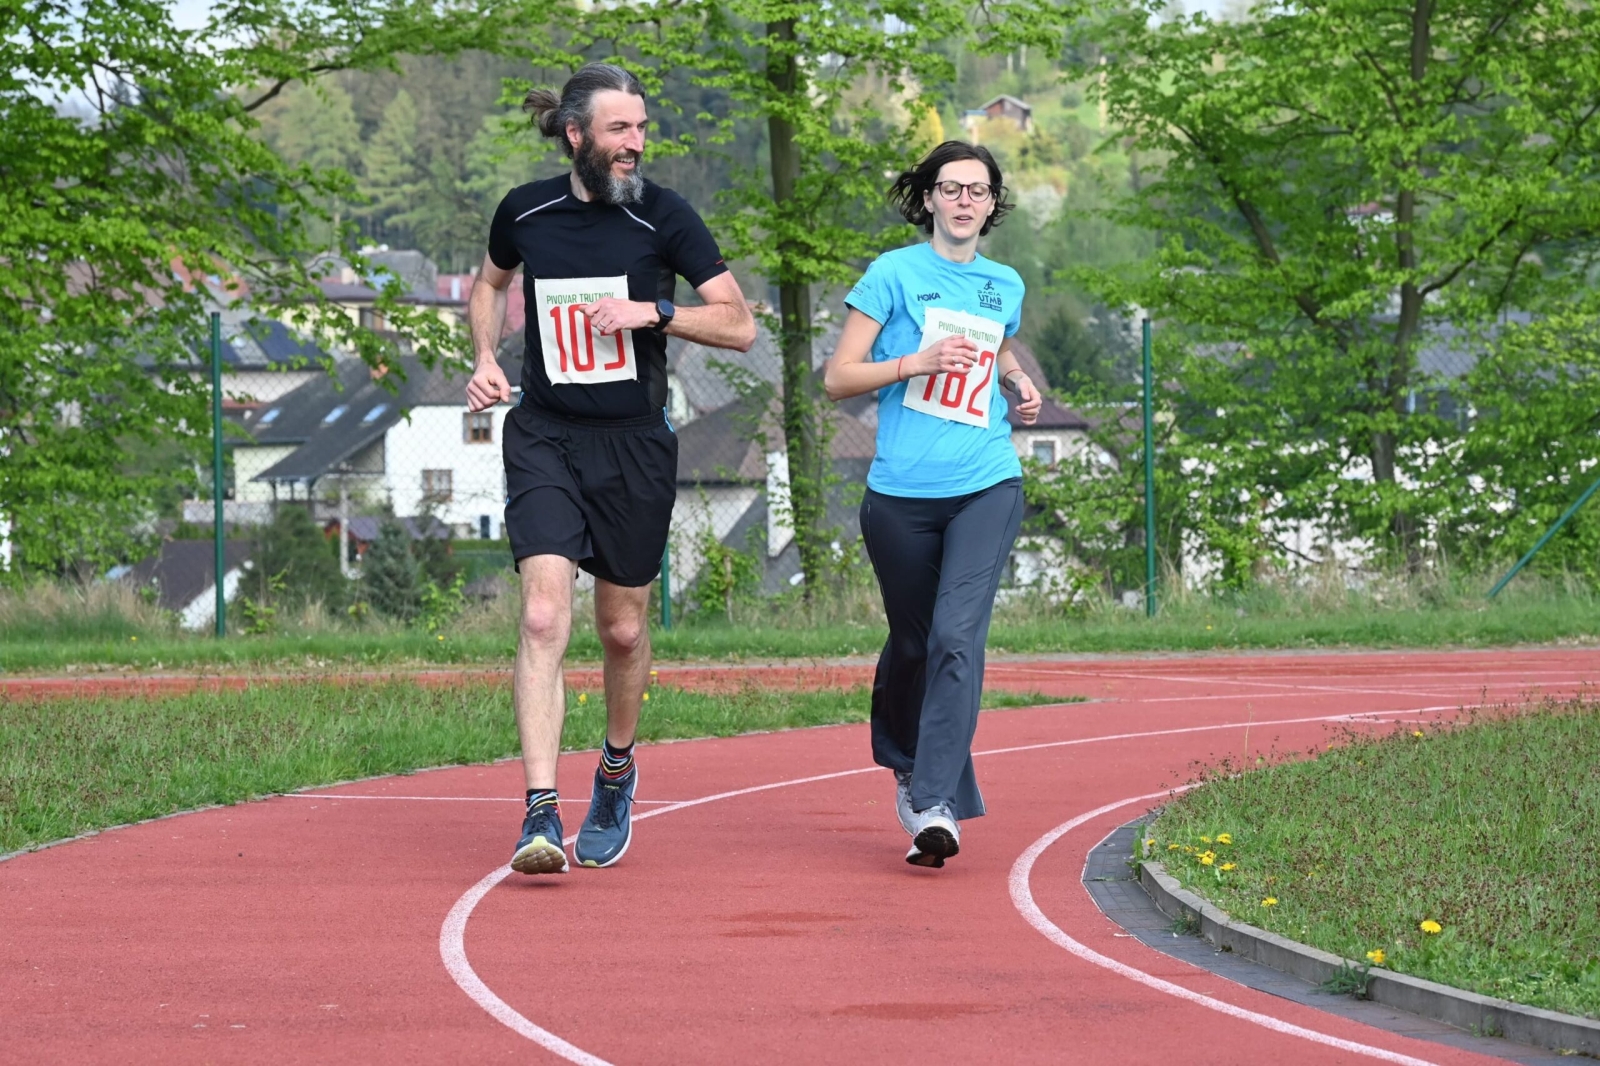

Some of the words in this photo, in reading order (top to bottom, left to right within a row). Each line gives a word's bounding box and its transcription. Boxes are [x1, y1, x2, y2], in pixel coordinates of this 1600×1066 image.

[547, 294, 577, 304] PIVOVAR
[917, 292, 941, 301] HOKA
[978, 294, 1002, 305] UTMB
[938, 320, 966, 335] PIVOVAR
[968, 328, 998, 344] TRUTNOV
